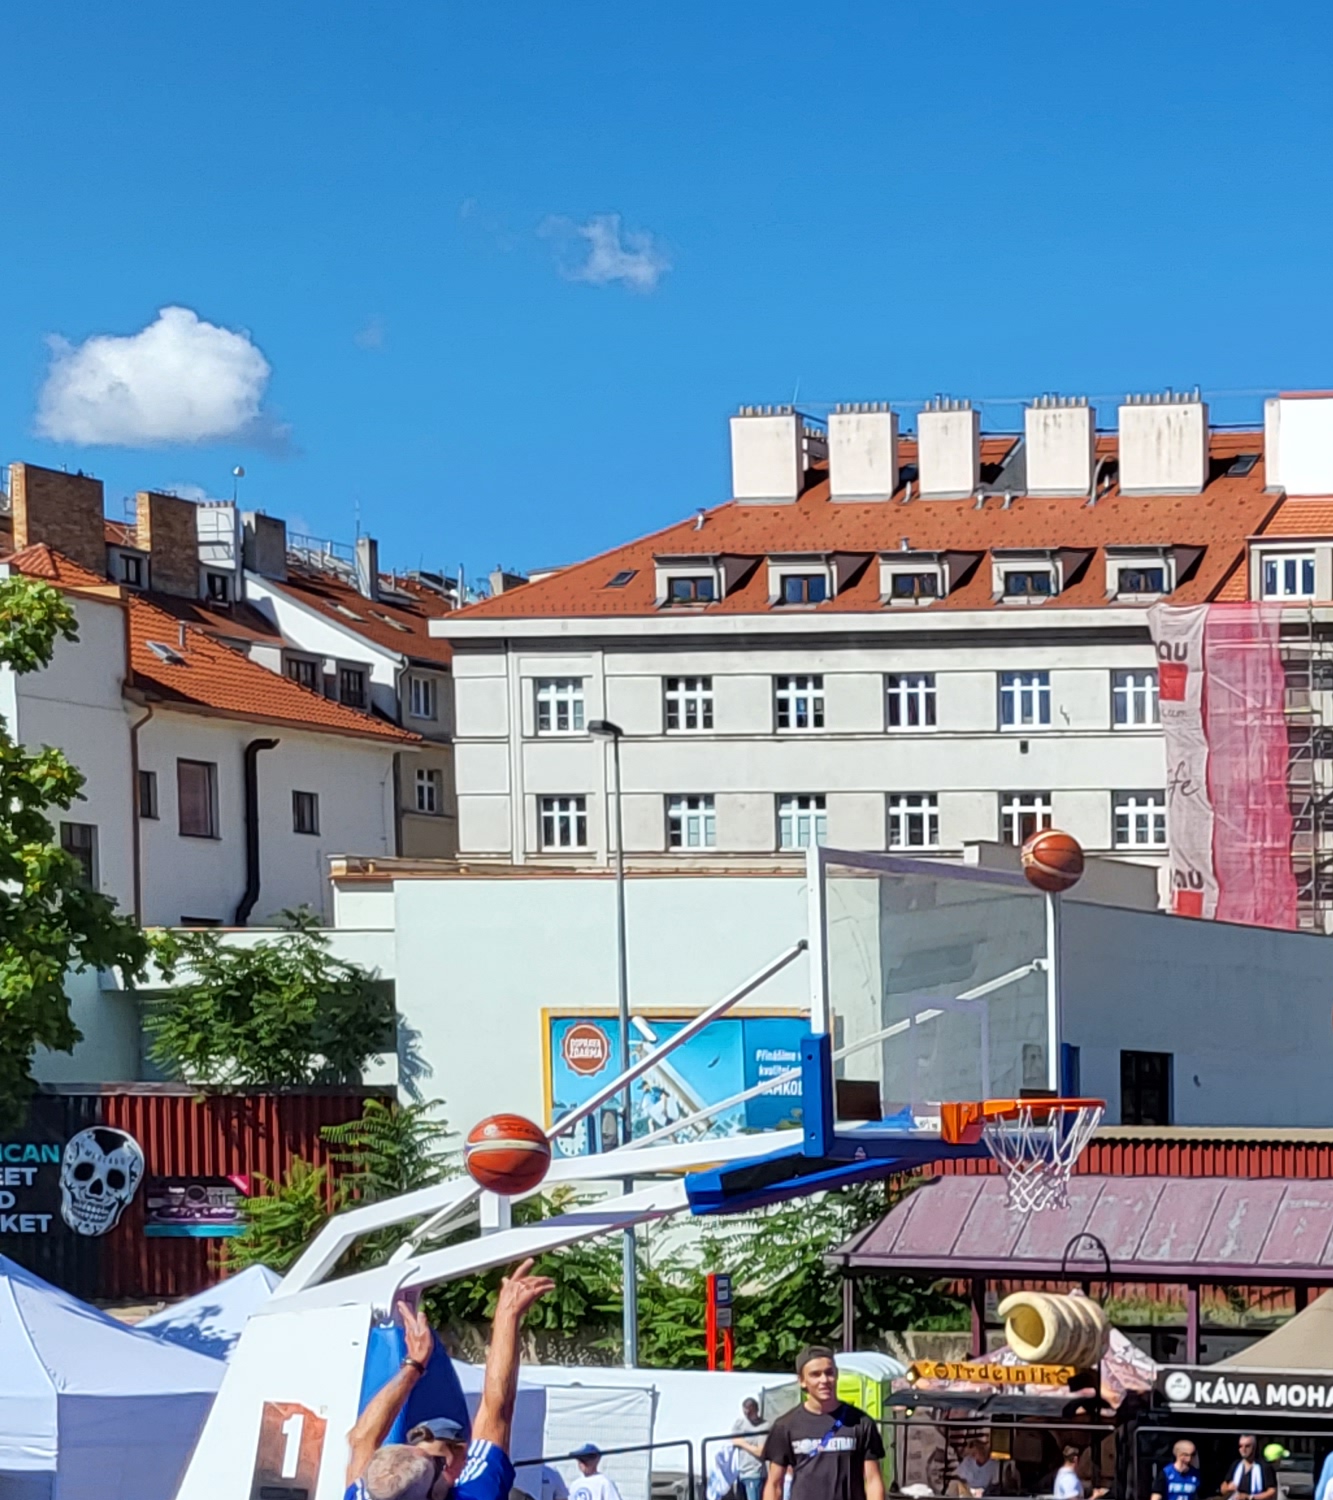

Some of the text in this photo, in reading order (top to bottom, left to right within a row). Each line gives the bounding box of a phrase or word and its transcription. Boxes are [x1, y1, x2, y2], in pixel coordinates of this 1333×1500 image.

[0, 1167, 38, 1186] ET
[0, 1214, 53, 1233] KET
[1194, 1377, 1261, 1406] KÁVA
[281, 1412, 305, 1479] 1
